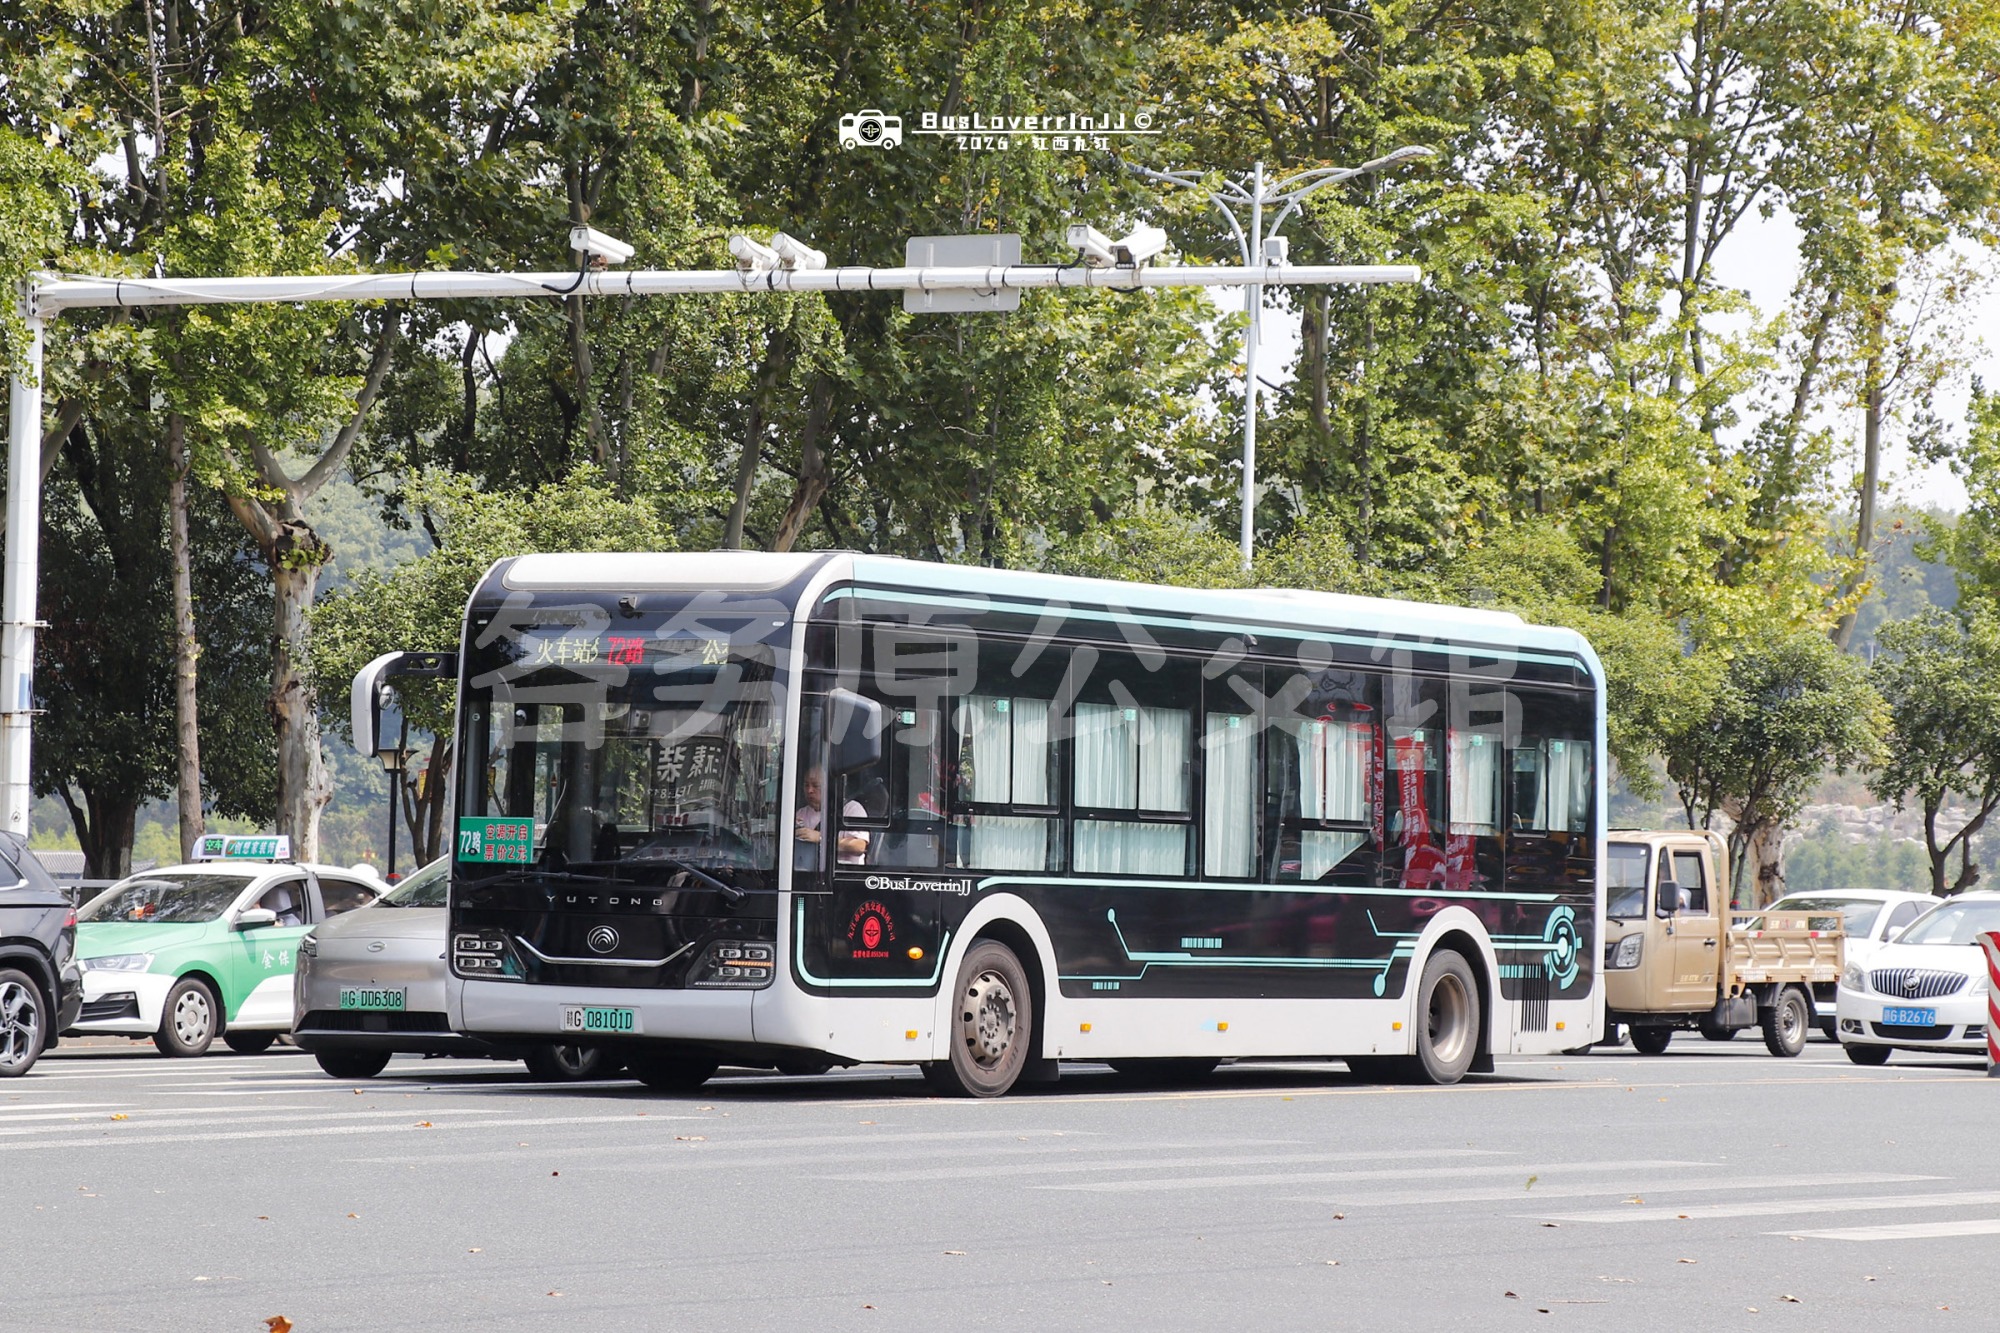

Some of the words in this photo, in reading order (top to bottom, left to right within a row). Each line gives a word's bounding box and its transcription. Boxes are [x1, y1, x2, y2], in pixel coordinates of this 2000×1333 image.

[485, 824, 528, 841] 空调开启
[460, 831, 481, 853] 72路
[484, 844, 528, 862] 票价2元
[546, 895, 663, 906] YUTONG
